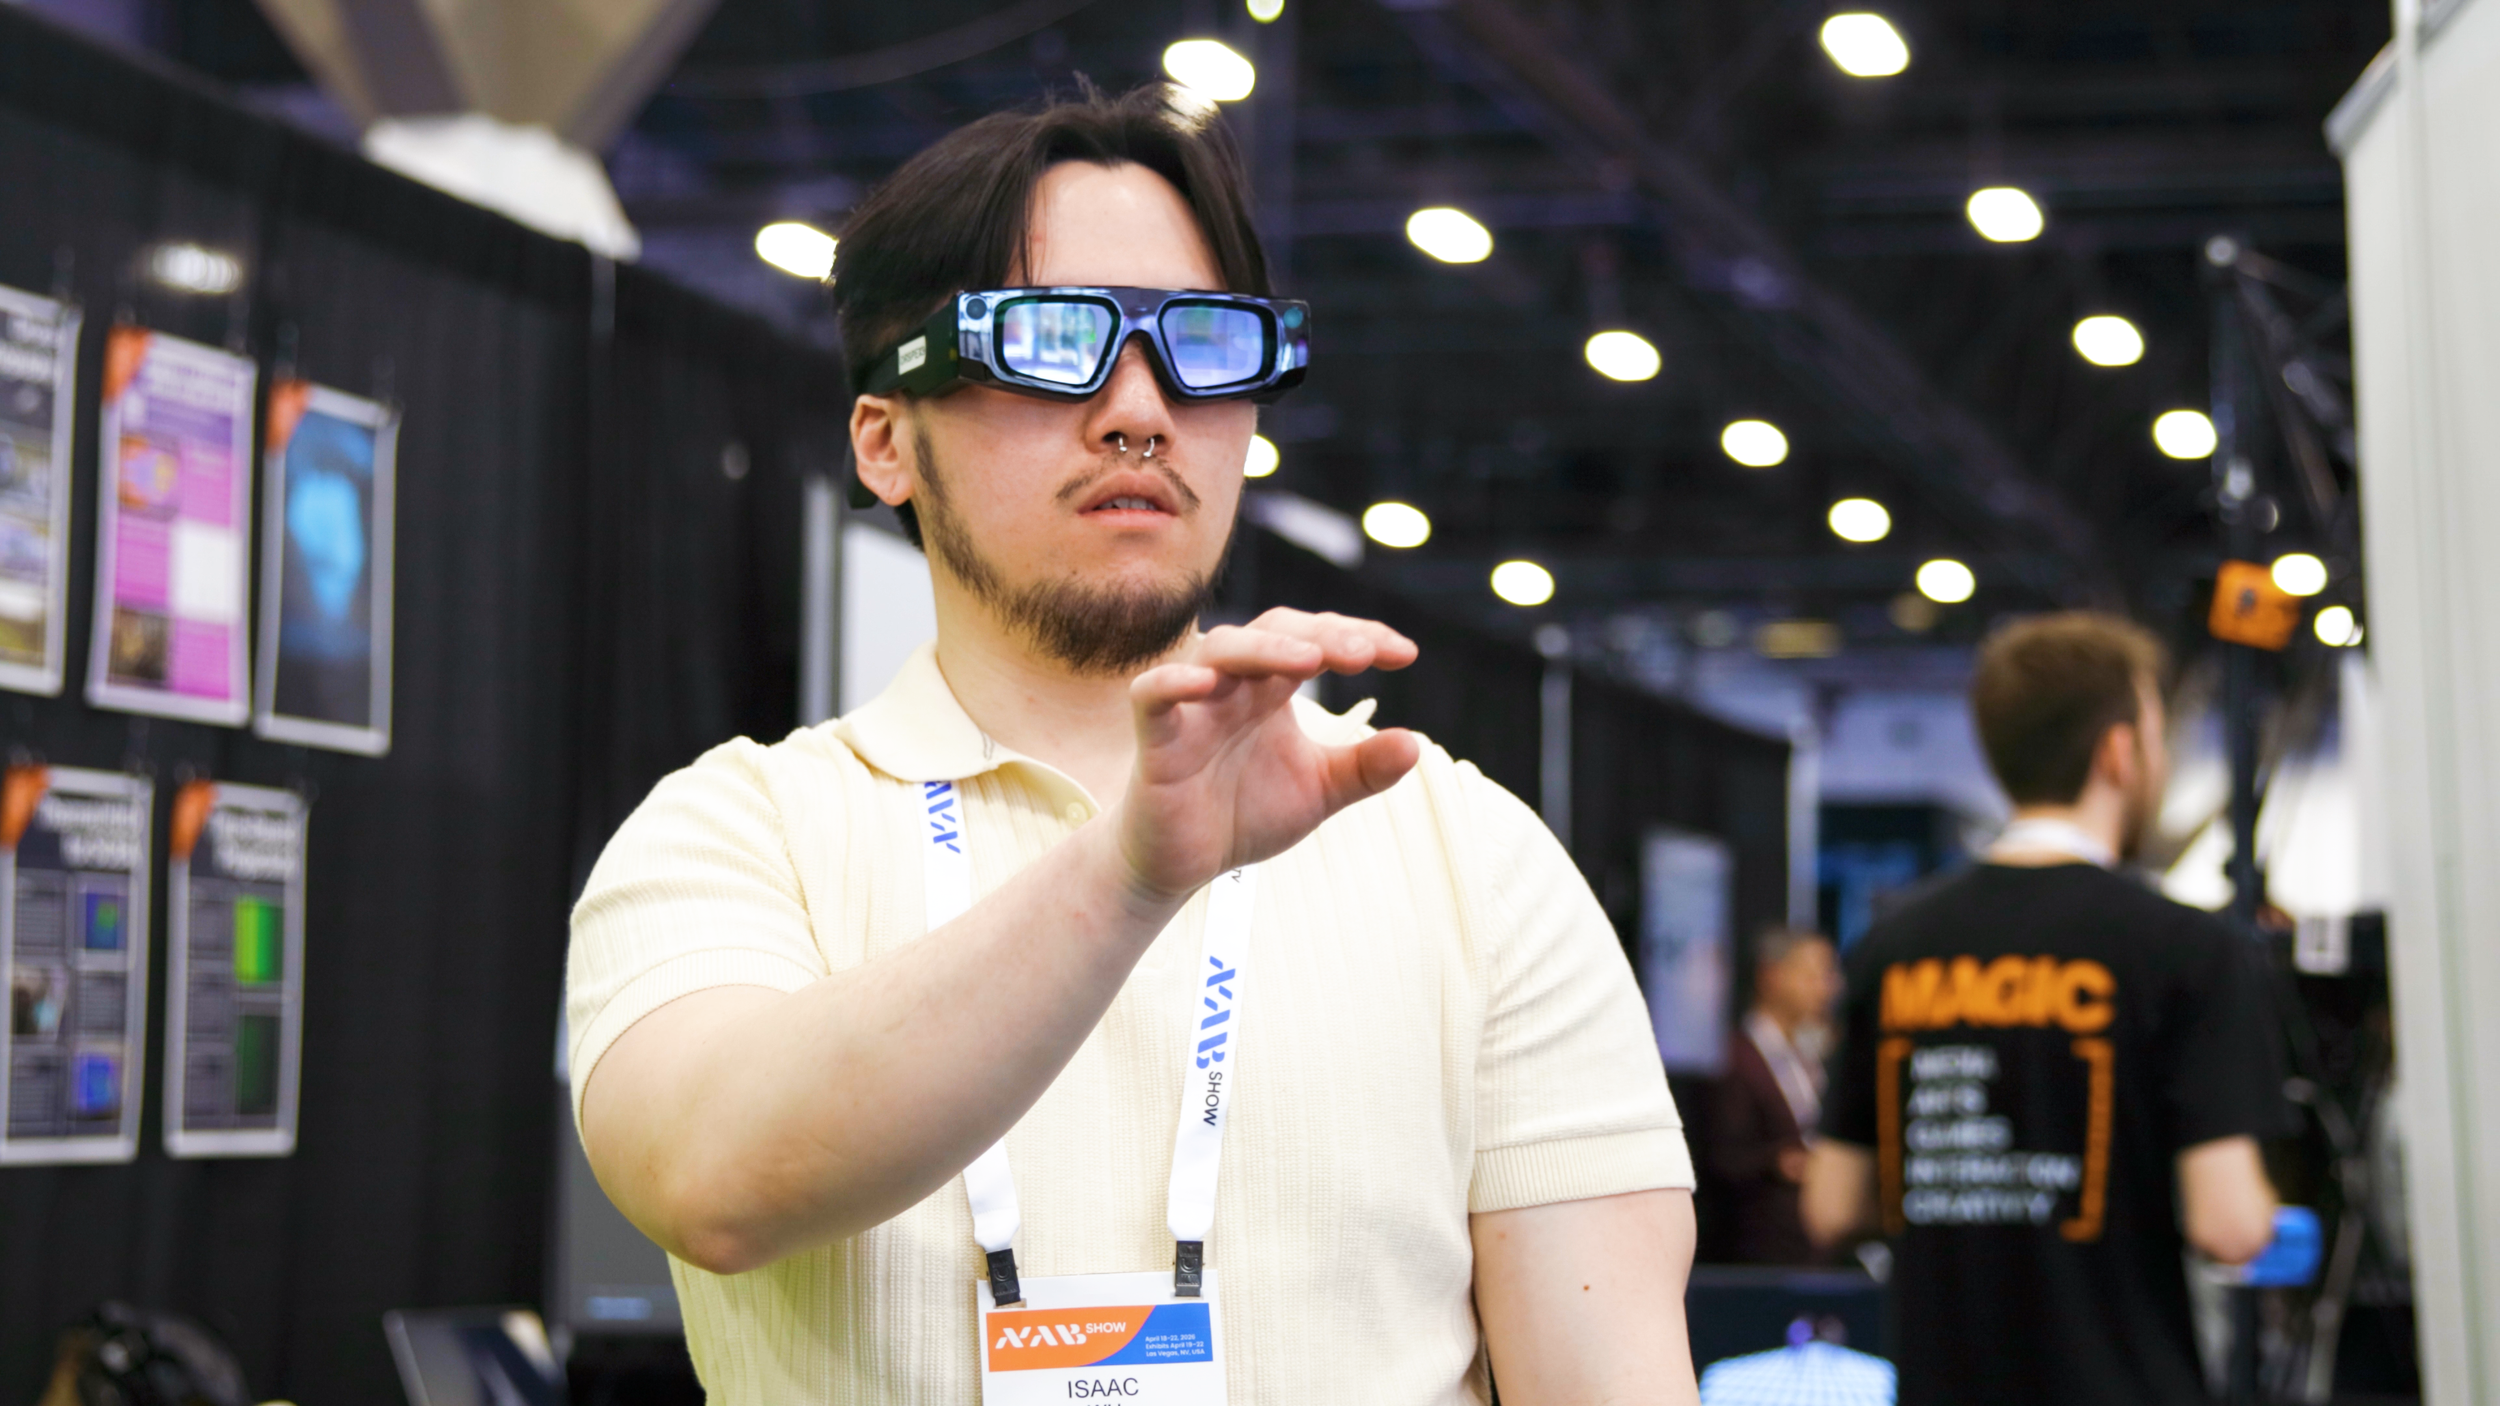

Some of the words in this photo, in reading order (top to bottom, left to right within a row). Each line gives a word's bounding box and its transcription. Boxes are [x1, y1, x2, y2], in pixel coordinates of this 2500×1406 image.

[1196, 955, 1236, 1069] NAB
[1881, 956, 2115, 1032] MAGIC
[1203, 1071, 1222, 1126] SHOW
[995, 1323, 1087, 1349] NAB
[1085, 1322, 1126, 1334] SHOW
[1158, 1350, 1179, 1358] Vegas,
[1068, 1377, 1139, 1399] ISAAC
